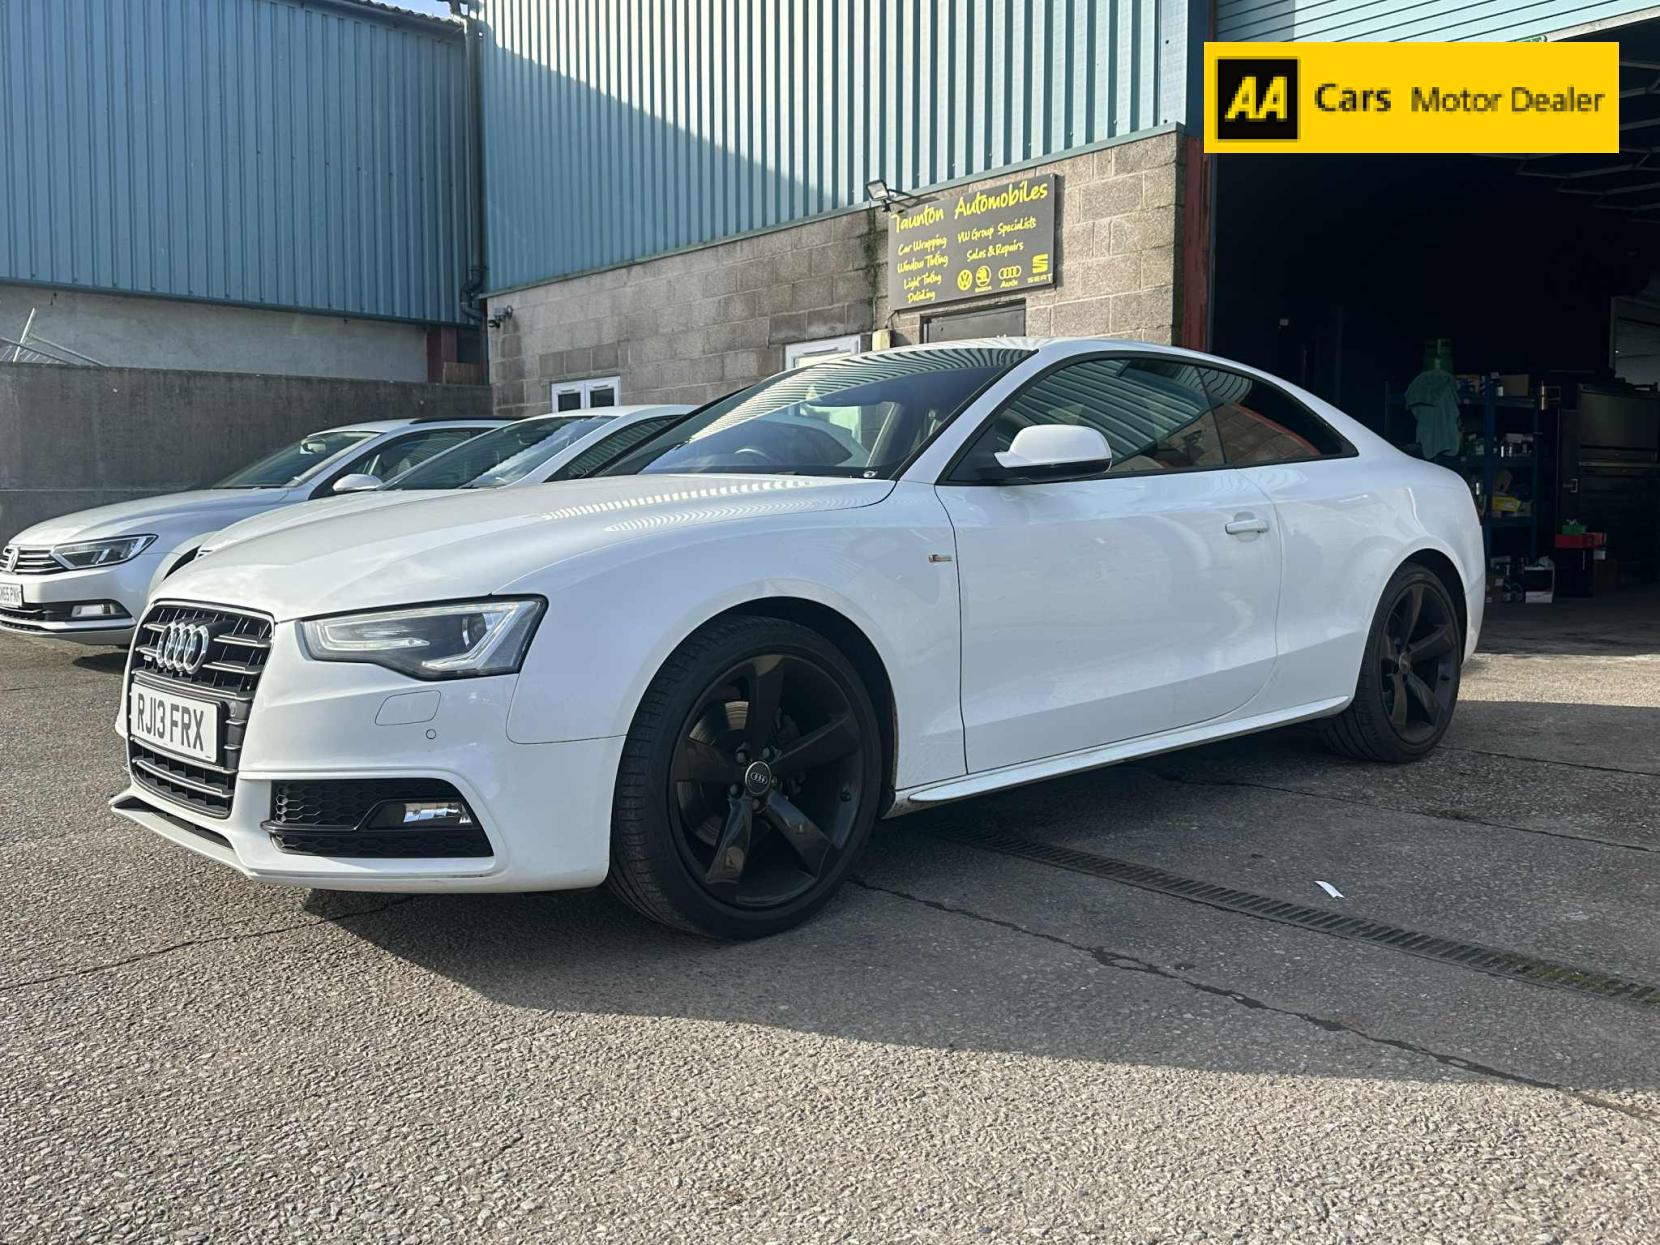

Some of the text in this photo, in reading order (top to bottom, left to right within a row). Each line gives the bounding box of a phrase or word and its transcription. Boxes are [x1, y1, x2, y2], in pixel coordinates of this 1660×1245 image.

[889, 180, 1049, 233] Taunton Automobiles
[971, 226, 994, 241] Group
[898, 234, 947, 256] Car Wrapping
[966, 248, 986, 262] Sales
[996, 239, 1024, 257] Repairs
[897, 257, 924, 274] Window
[137, 692, 204, 752] RJ13 FRX
